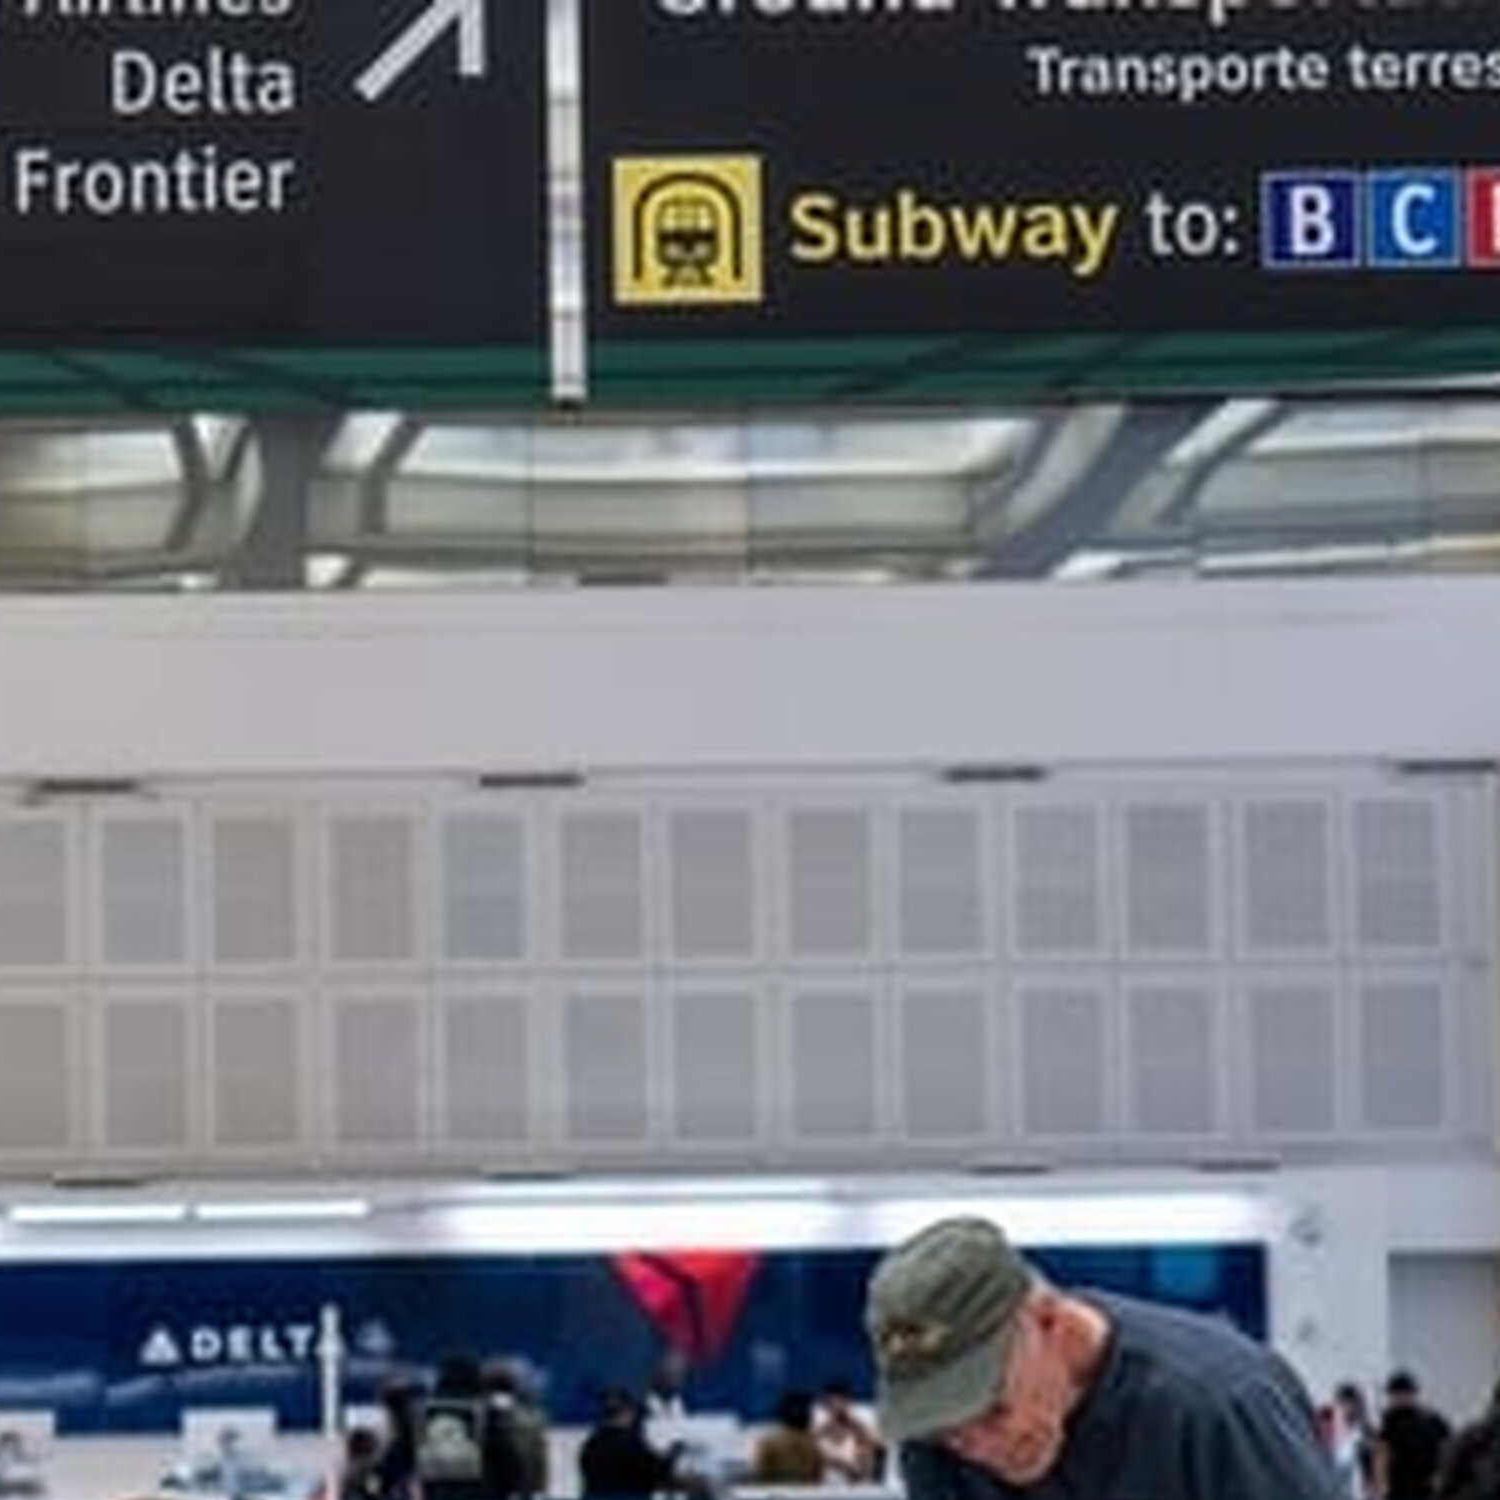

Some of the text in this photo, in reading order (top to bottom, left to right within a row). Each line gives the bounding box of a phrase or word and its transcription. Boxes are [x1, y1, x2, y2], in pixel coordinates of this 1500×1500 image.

[111, 47, 295, 114] Delta
[1026, 46, 1330, 102] Transporte
[15, 145, 295, 213] Frontier
[790, 190, 1119, 277] Subway
[1144, 192, 1239, 255] to:
[1289, 184, 1336, 255] B
[1391, 184, 1438, 255] C
